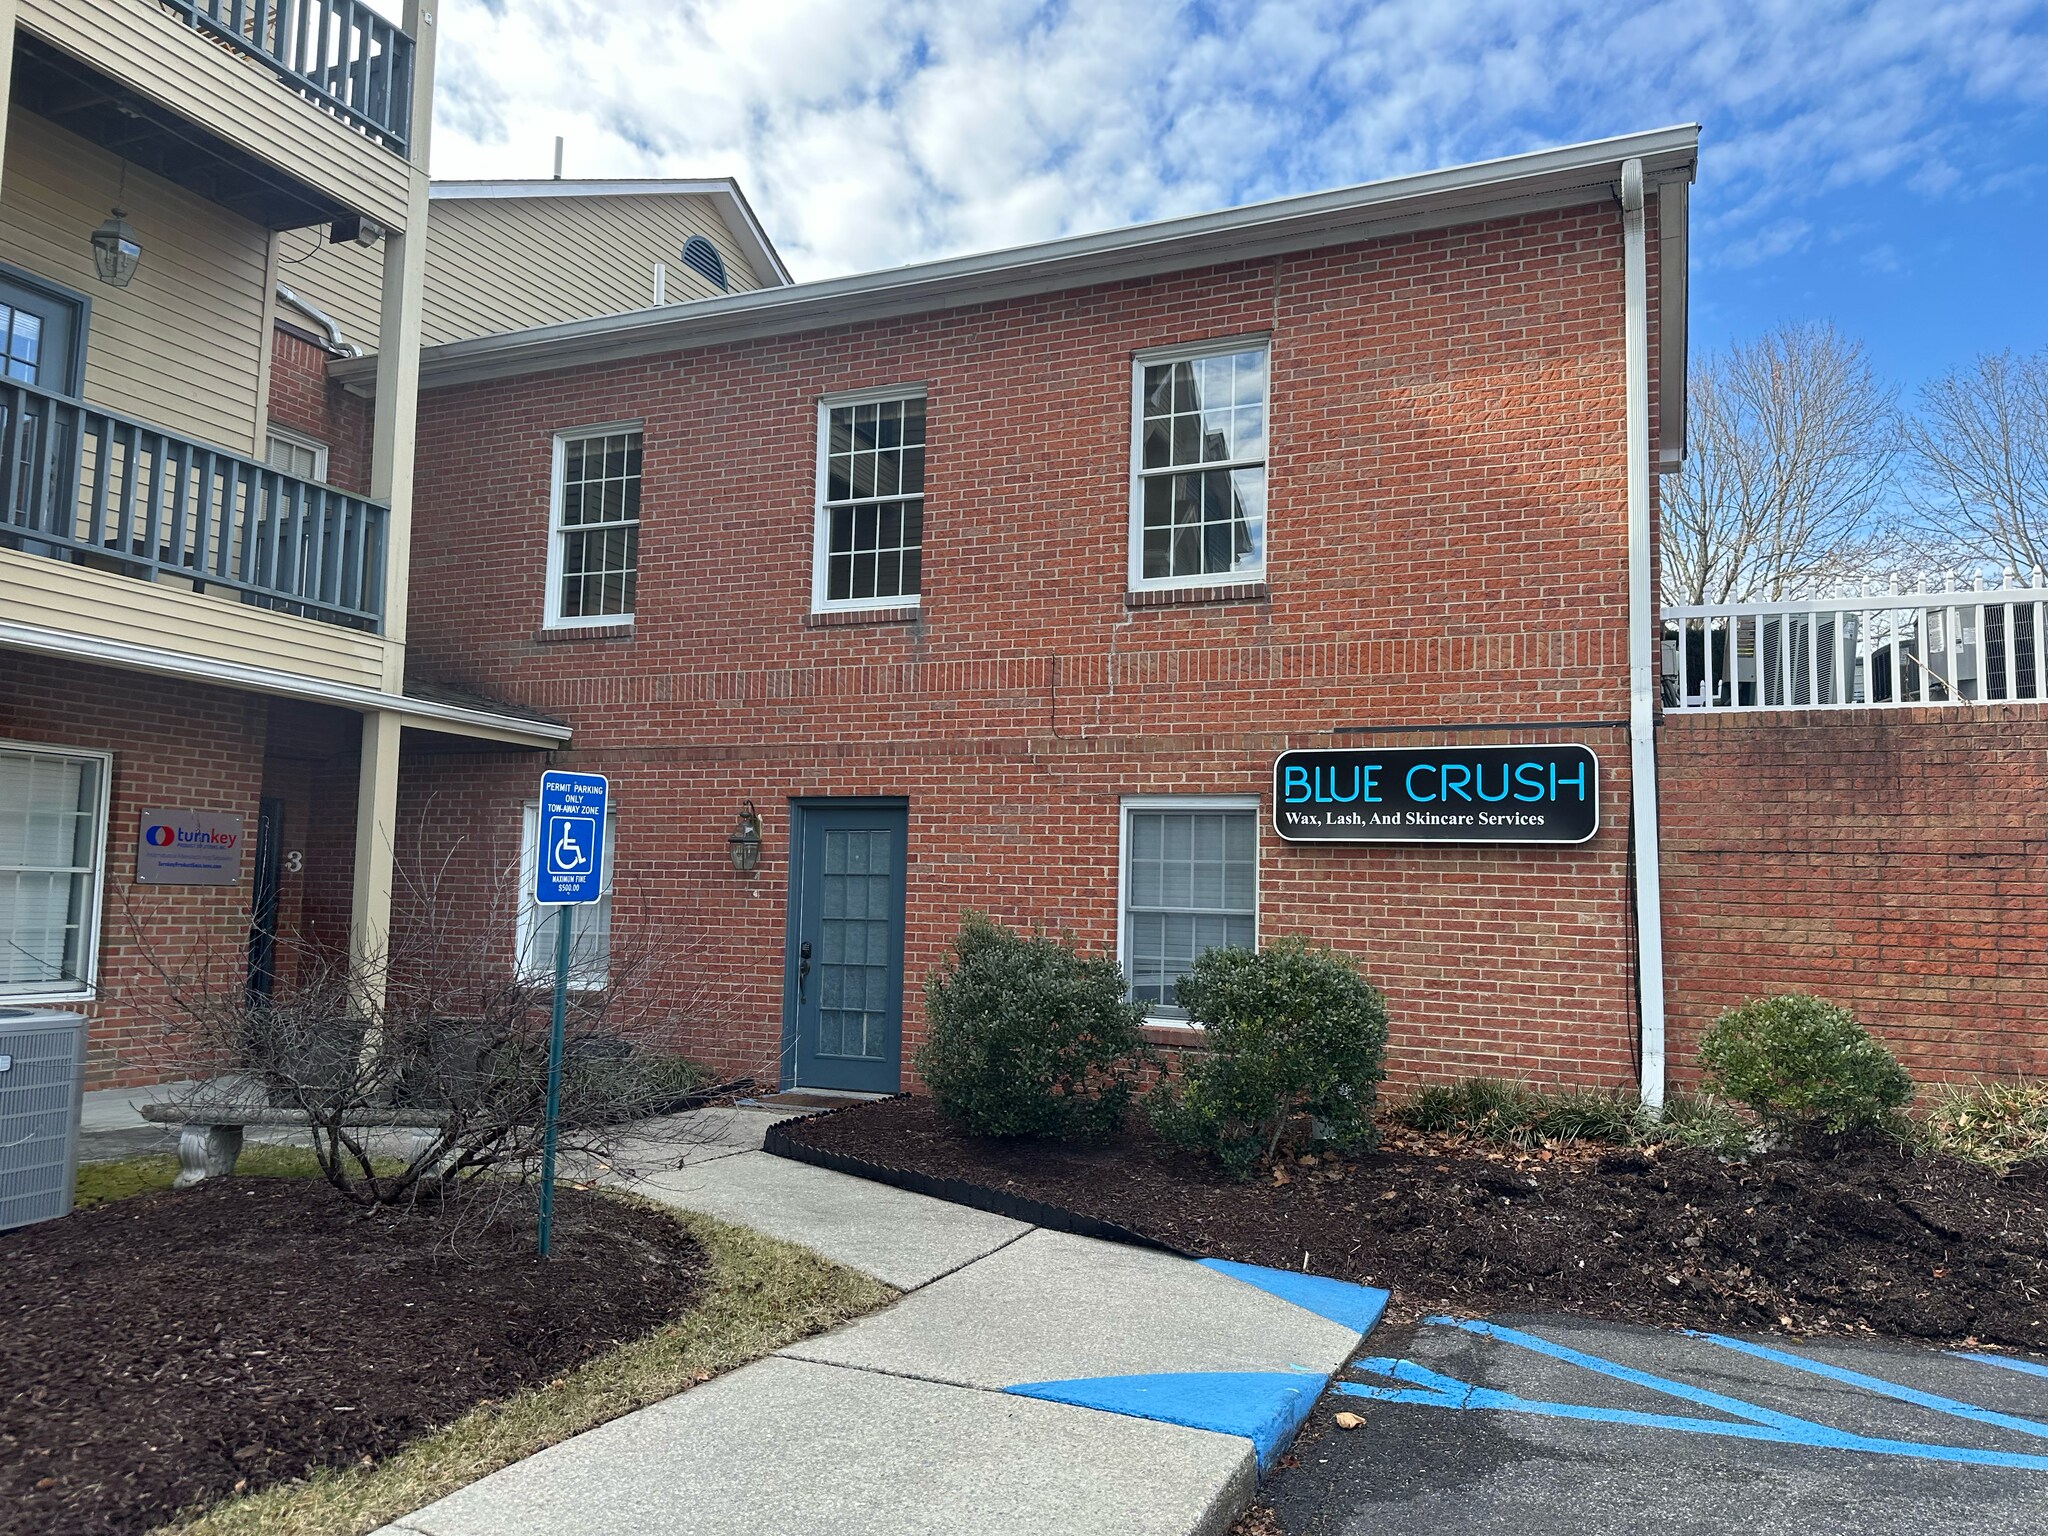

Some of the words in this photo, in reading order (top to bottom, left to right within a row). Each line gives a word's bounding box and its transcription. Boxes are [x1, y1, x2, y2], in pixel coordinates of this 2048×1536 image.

[1285, 766, 1382, 802] BLUE
[1405, 761, 1585, 802] CRUSH
[546, 782, 571, 793] PERMIT
[574, 784, 603, 795] PARKING
[565, 794, 584, 804] ONLY
[547, 803, 580, 814] TOW-AWAY
[581, 806, 599, 815] ZONE
[1285, 811, 1322, 827] Wax,
[1326, 811, 1365, 827] Lash,
[1369, 811, 1401, 826] And
[1405, 811, 1474, 826] Skincare
[1478, 811, 1545, 826] Services
[177, 827, 237, 848] turnkey
[285, 850, 302, 873] 3
[552, 875, 575, 883] MAXIMUM
[575, 875, 587, 883] FINE
[558, 884, 580, 892] $500.00
